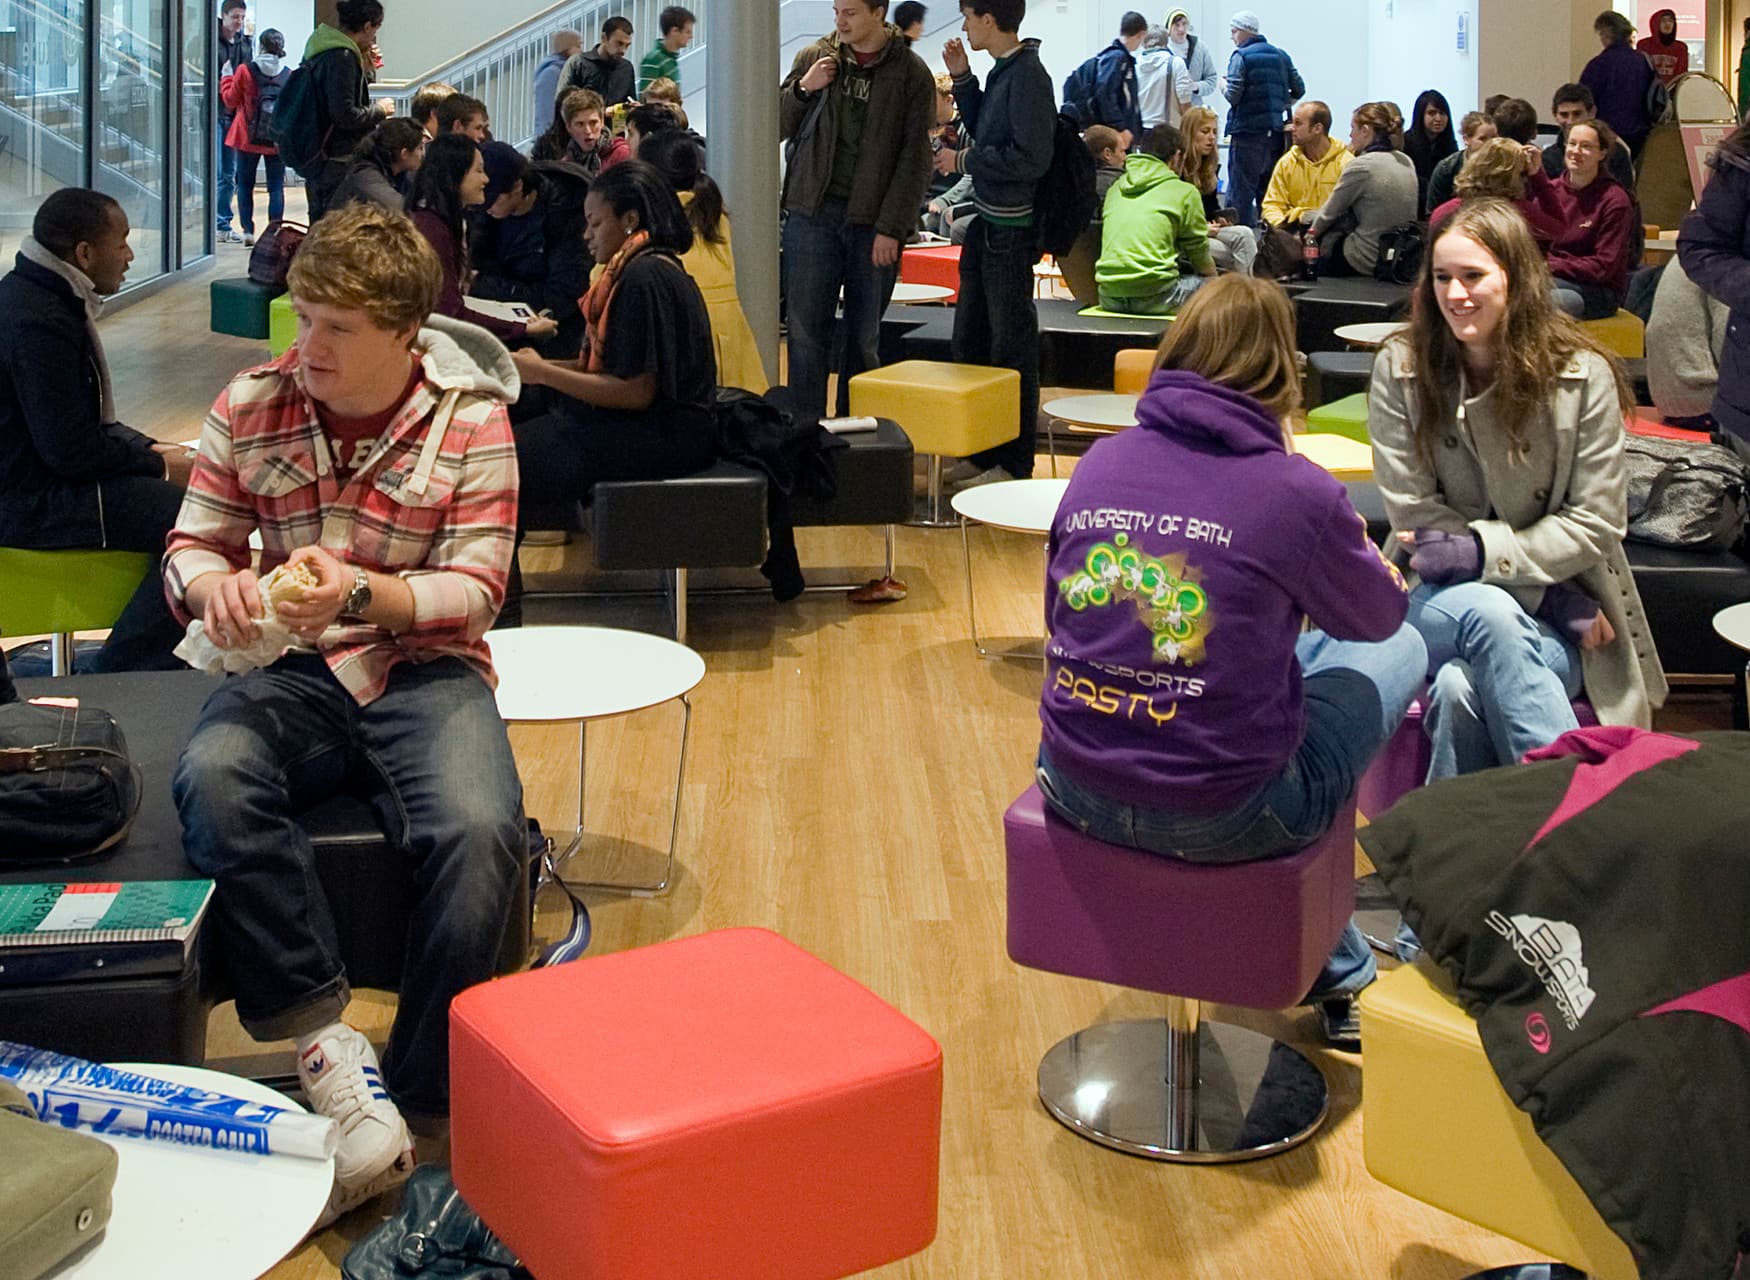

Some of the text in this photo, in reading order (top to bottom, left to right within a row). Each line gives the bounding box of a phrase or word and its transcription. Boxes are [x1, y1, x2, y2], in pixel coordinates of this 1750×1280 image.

[1065, 508, 1233, 549] UNIVERSITY OF BATH
[1052, 666, 1178, 727] PASTY
[1483, 910, 1580, 1032] SNOWSPORTS
